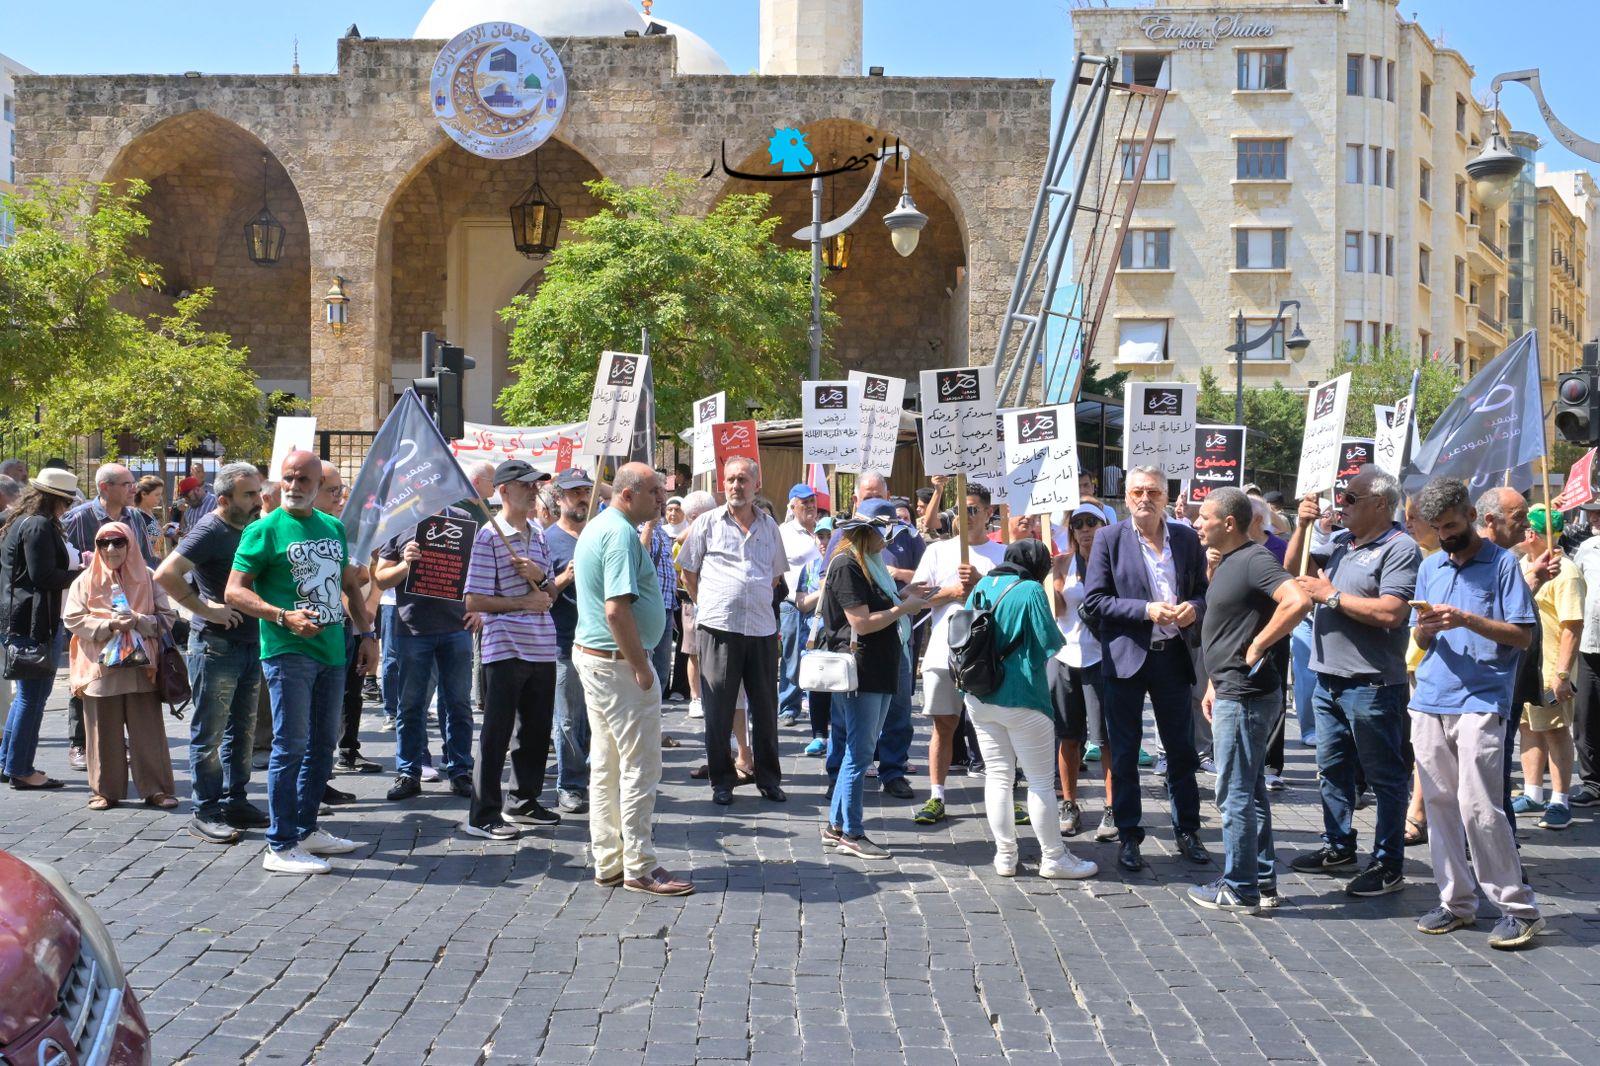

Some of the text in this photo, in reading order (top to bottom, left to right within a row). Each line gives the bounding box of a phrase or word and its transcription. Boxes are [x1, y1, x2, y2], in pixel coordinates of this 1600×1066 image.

[1140, 13, 1275, 42] Etoile Suites
[1179, 40, 1215, 49] HOTEL
[1195, 456, 1237, 469] ممنوع
[1196, 469, 1235, 483] شطب
